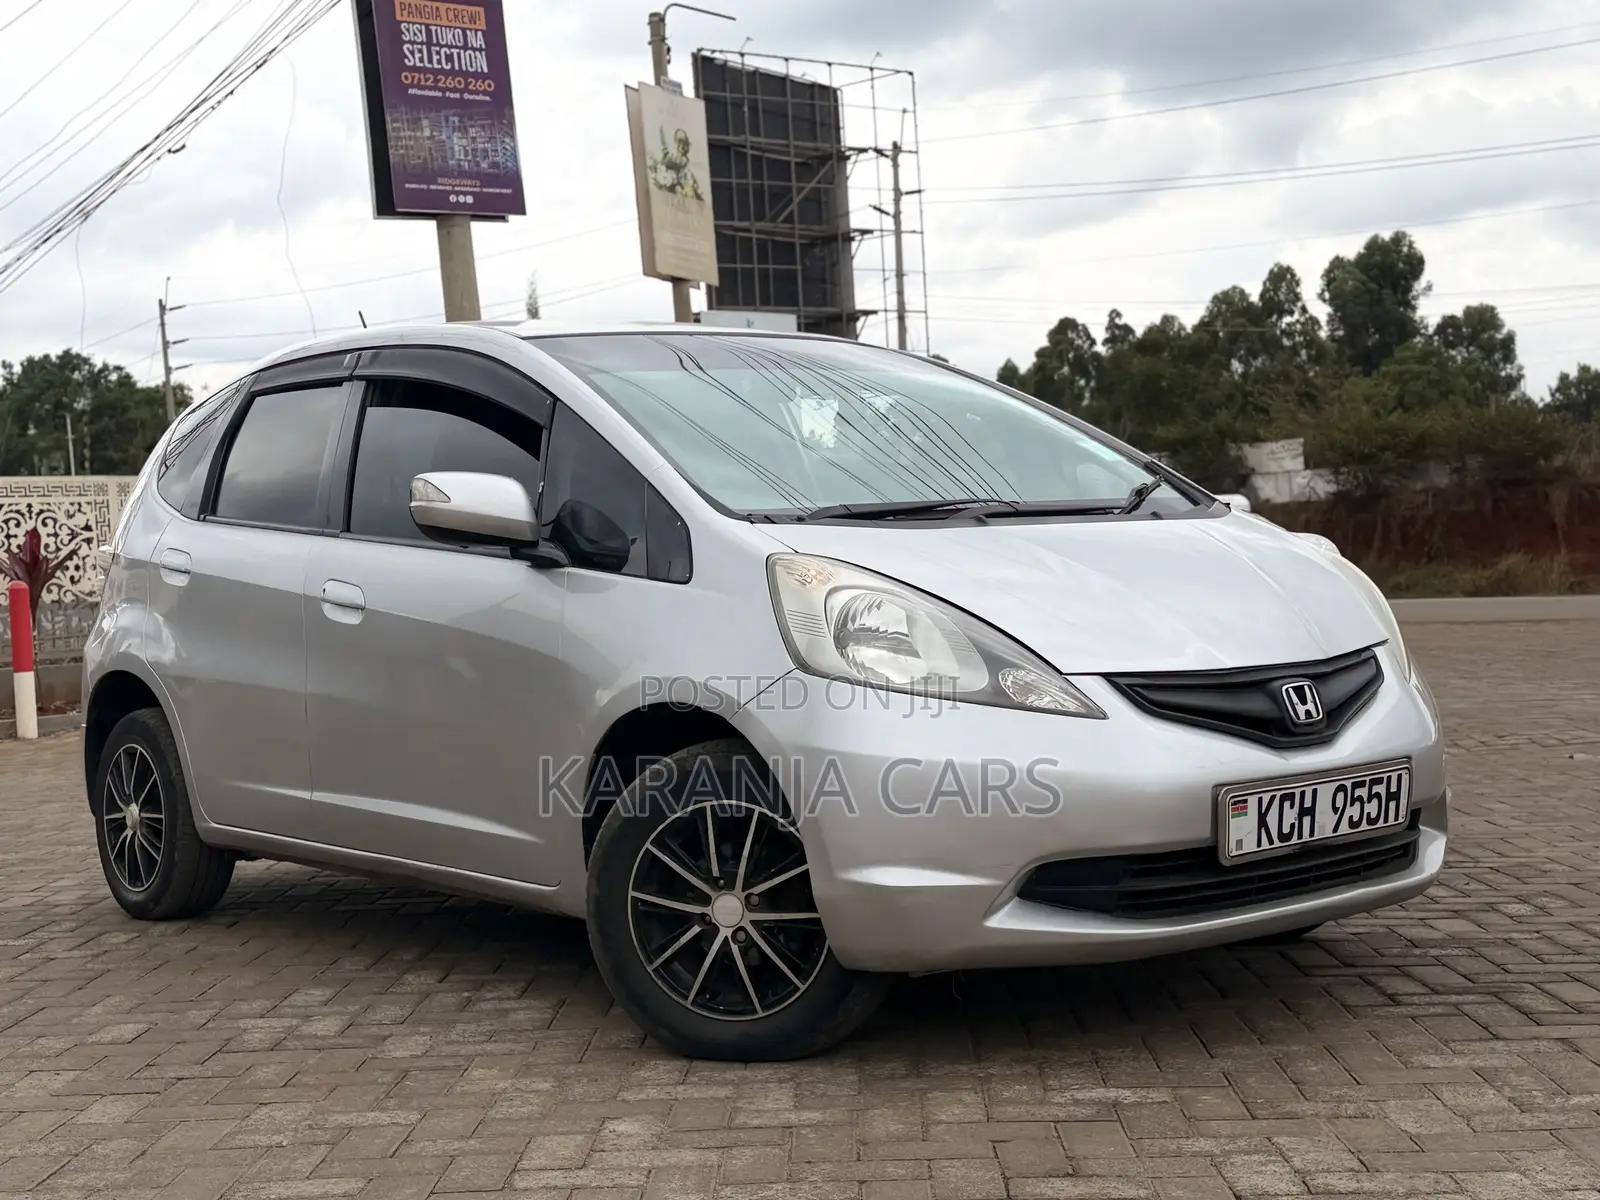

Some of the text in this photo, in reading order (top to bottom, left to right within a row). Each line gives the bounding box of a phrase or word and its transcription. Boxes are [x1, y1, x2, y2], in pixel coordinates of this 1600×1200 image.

[400, 2, 482, 26] PANGIA CREW!
[401, 23, 486, 49] SISI TUKO NA
[402, 44, 488, 73] SELECTION
[401, 71, 495, 92] 0712 260 260
[1257, 772, 1403, 849] KCH 955H
